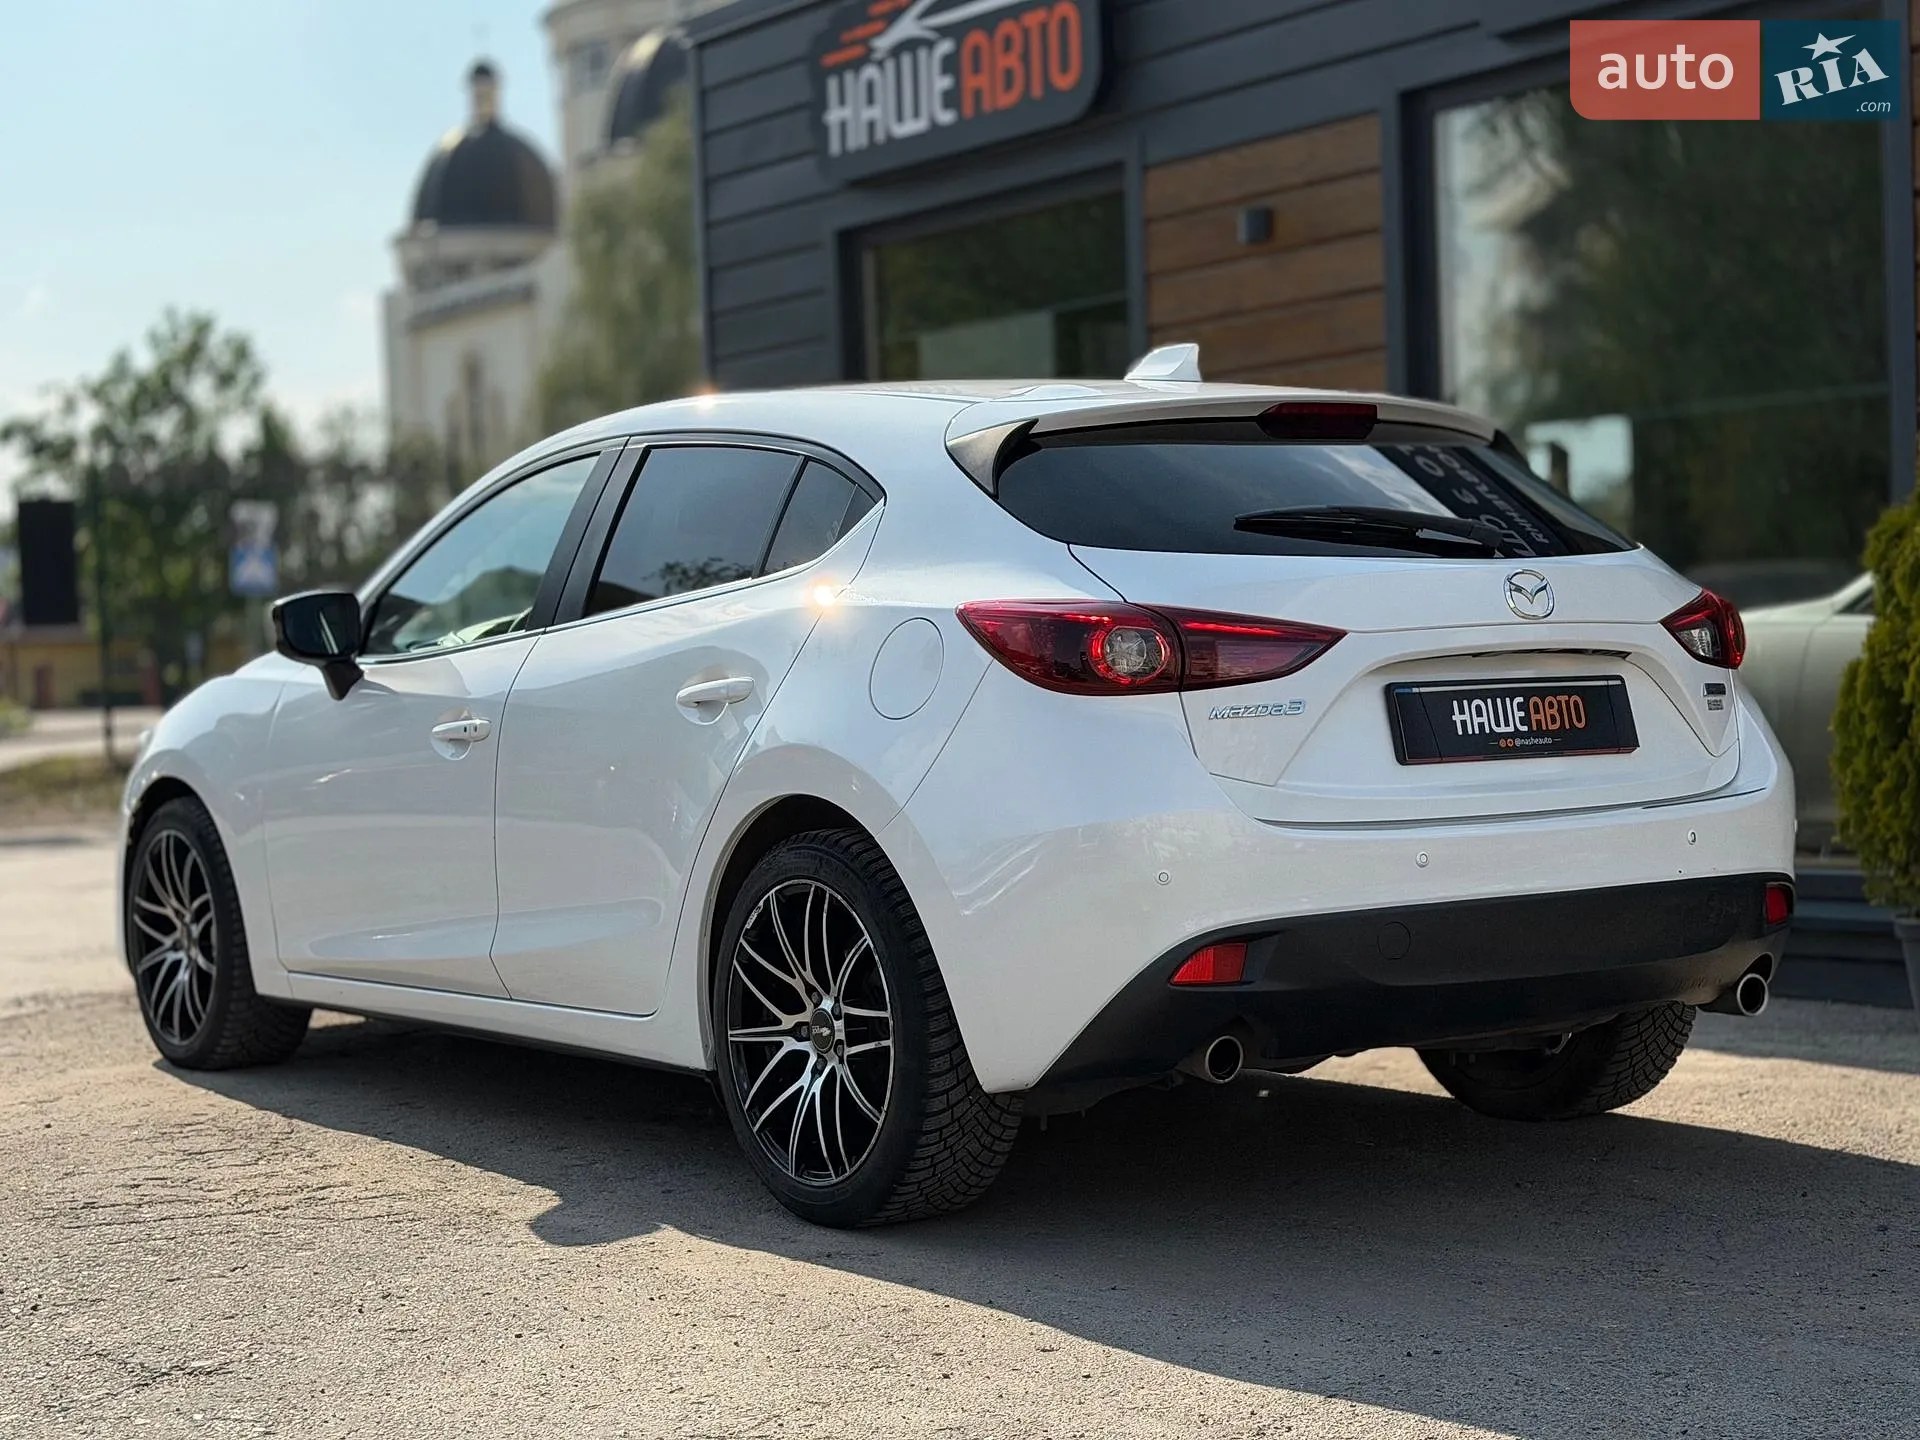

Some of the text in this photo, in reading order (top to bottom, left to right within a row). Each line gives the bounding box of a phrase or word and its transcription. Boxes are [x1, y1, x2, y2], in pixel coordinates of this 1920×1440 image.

[823, 2, 1082, 157] НАШЕ АВТО
[1452, 695, 1587, 735] НАШЕ АВТО
